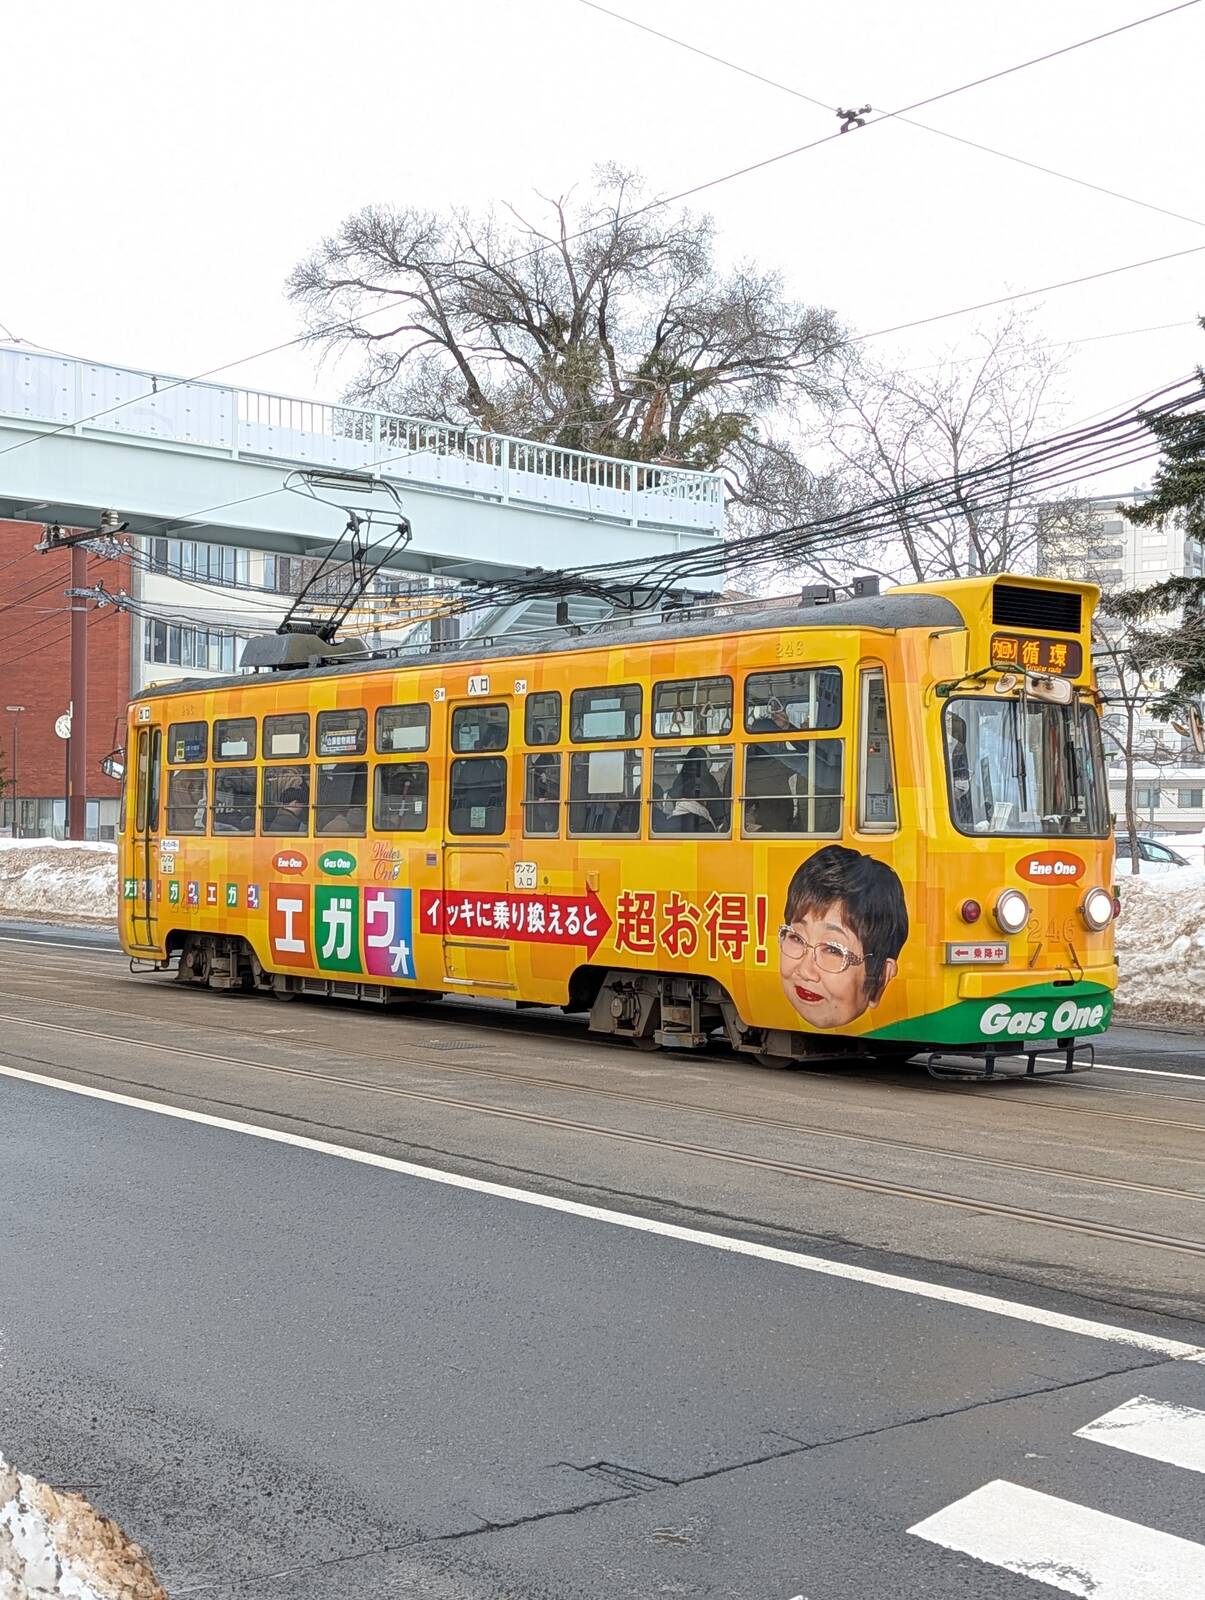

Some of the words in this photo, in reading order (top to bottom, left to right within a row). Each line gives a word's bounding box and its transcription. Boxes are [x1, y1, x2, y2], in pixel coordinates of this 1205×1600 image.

[1022, 640, 1068, 668] 循環
[469, 678, 488, 693] 入口
[277, 857, 289, 867] Ene
[290, 858, 302, 868] One
[323, 857, 336, 868] Gas
[337, 858, 351, 869] One
[515, 863, 536, 873] ワンマン
[1029, 861, 1052, 875] Ene
[1054, 862, 1077, 875] One
[518, 877, 533, 886] 入口
[426, 898, 598, 937] イッキに乗り換えると
[613, 889, 768, 966] 超お得!
[1027, 918, 1075, 944] 246
[973, 947, 1004, 959] 乗降中
[979, 1003, 1048, 1035] Gas
[1052, 1000, 1104, 1033] One
